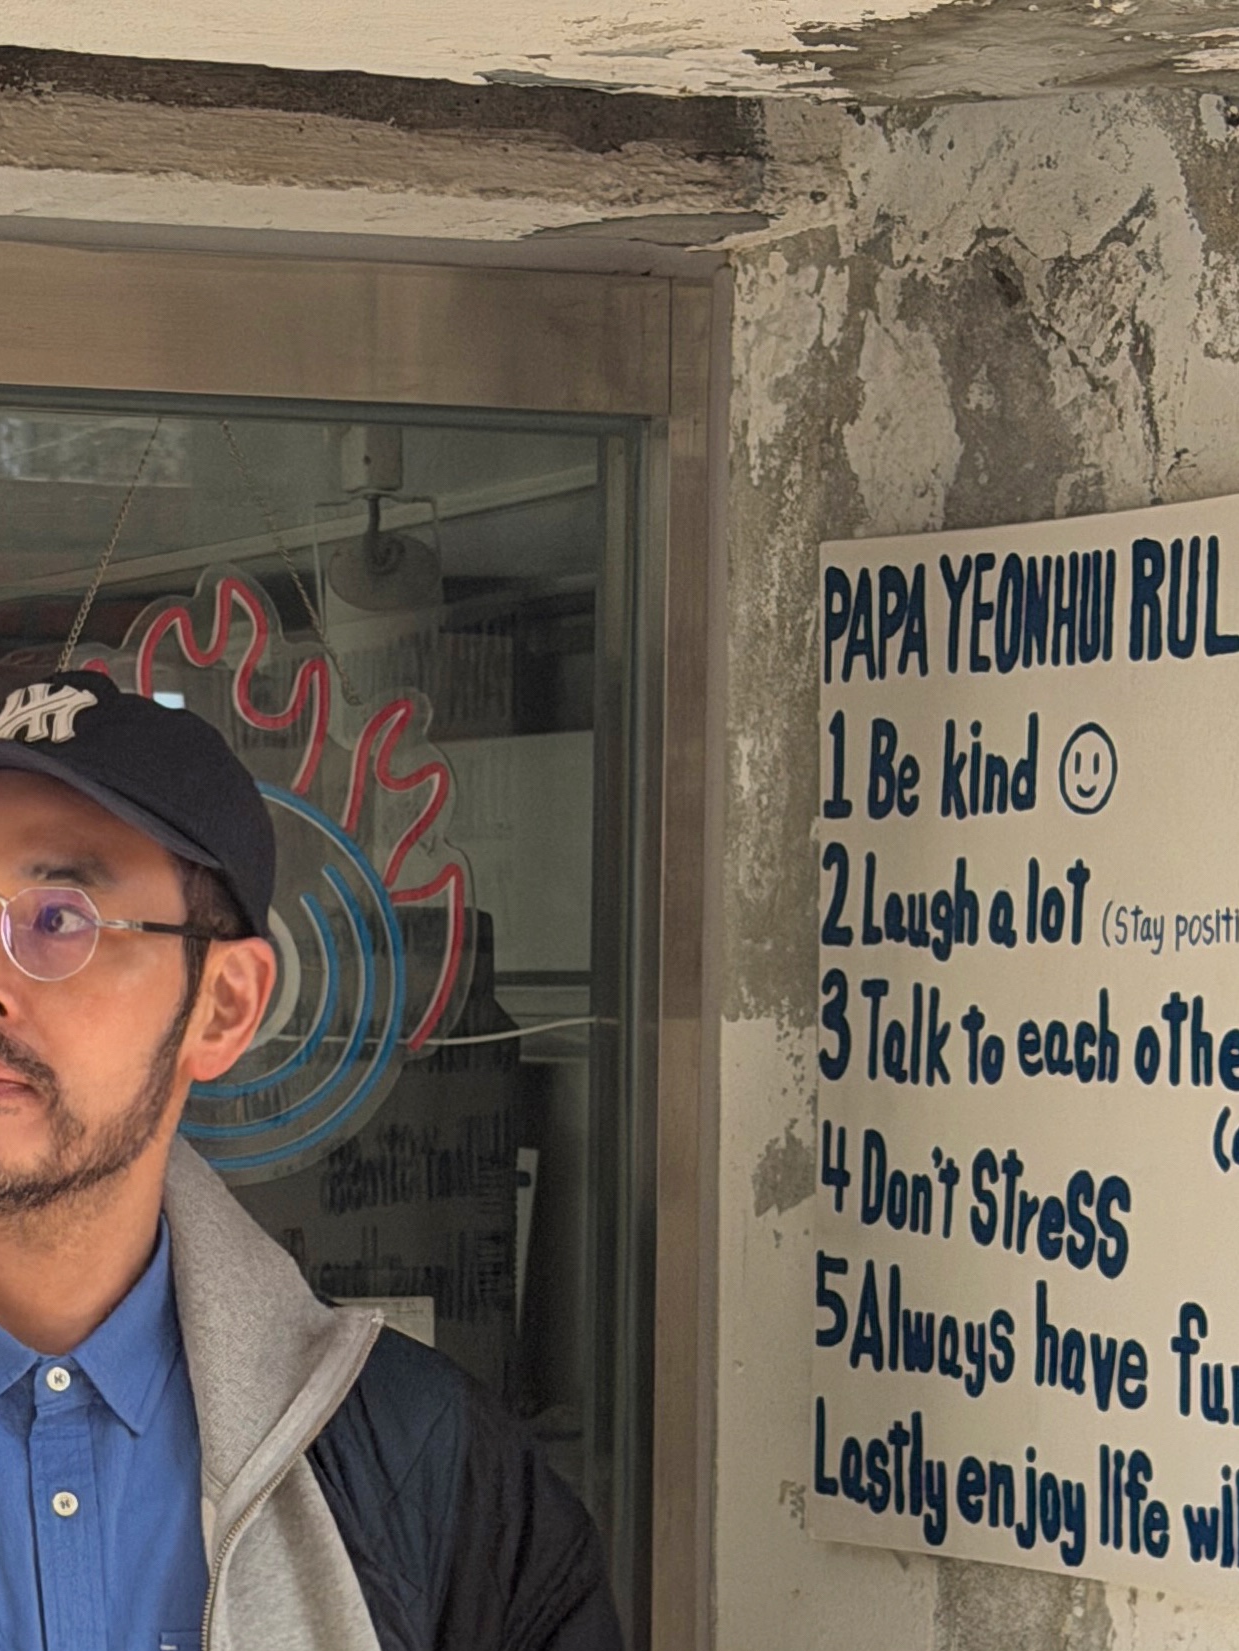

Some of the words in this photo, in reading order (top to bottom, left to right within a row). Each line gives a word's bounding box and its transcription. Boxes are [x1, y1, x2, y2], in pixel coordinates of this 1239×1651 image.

[824, 562, 929, 685] PAPA
[939, 548, 1117, 675] YEONHUI
[1129, 535, 1239, 662] RUL
[823, 709, 854, 820] 1
[867, 717, 921, 821] Be
[940, 711, 1039, 821] kind
[821, 841, 855, 948] 2
[861, 851, 980, 962] Laugh
[1026, 857, 1091, 946] lot
[1102, 900, 1165, 956] (Stay
[817, 967, 853, 1082] 3
[860, 978, 952, 1088] Talk
[960, 1004, 1005, 1085] to
[1017, 987, 1120, 1084] each
[820, 1119, 852, 1214] 4
[860, 1128, 961, 1239] Don't
[969, 1147, 1131, 1280] Stress
[849, 1258, 1016, 1399] Always
[1034, 1279, 1148, 1412] have
[814, 1395, 948, 1547] Lastly
[955, 1446, 1087, 1568] enjoy
[1099, 1444, 1170, 1559] life
